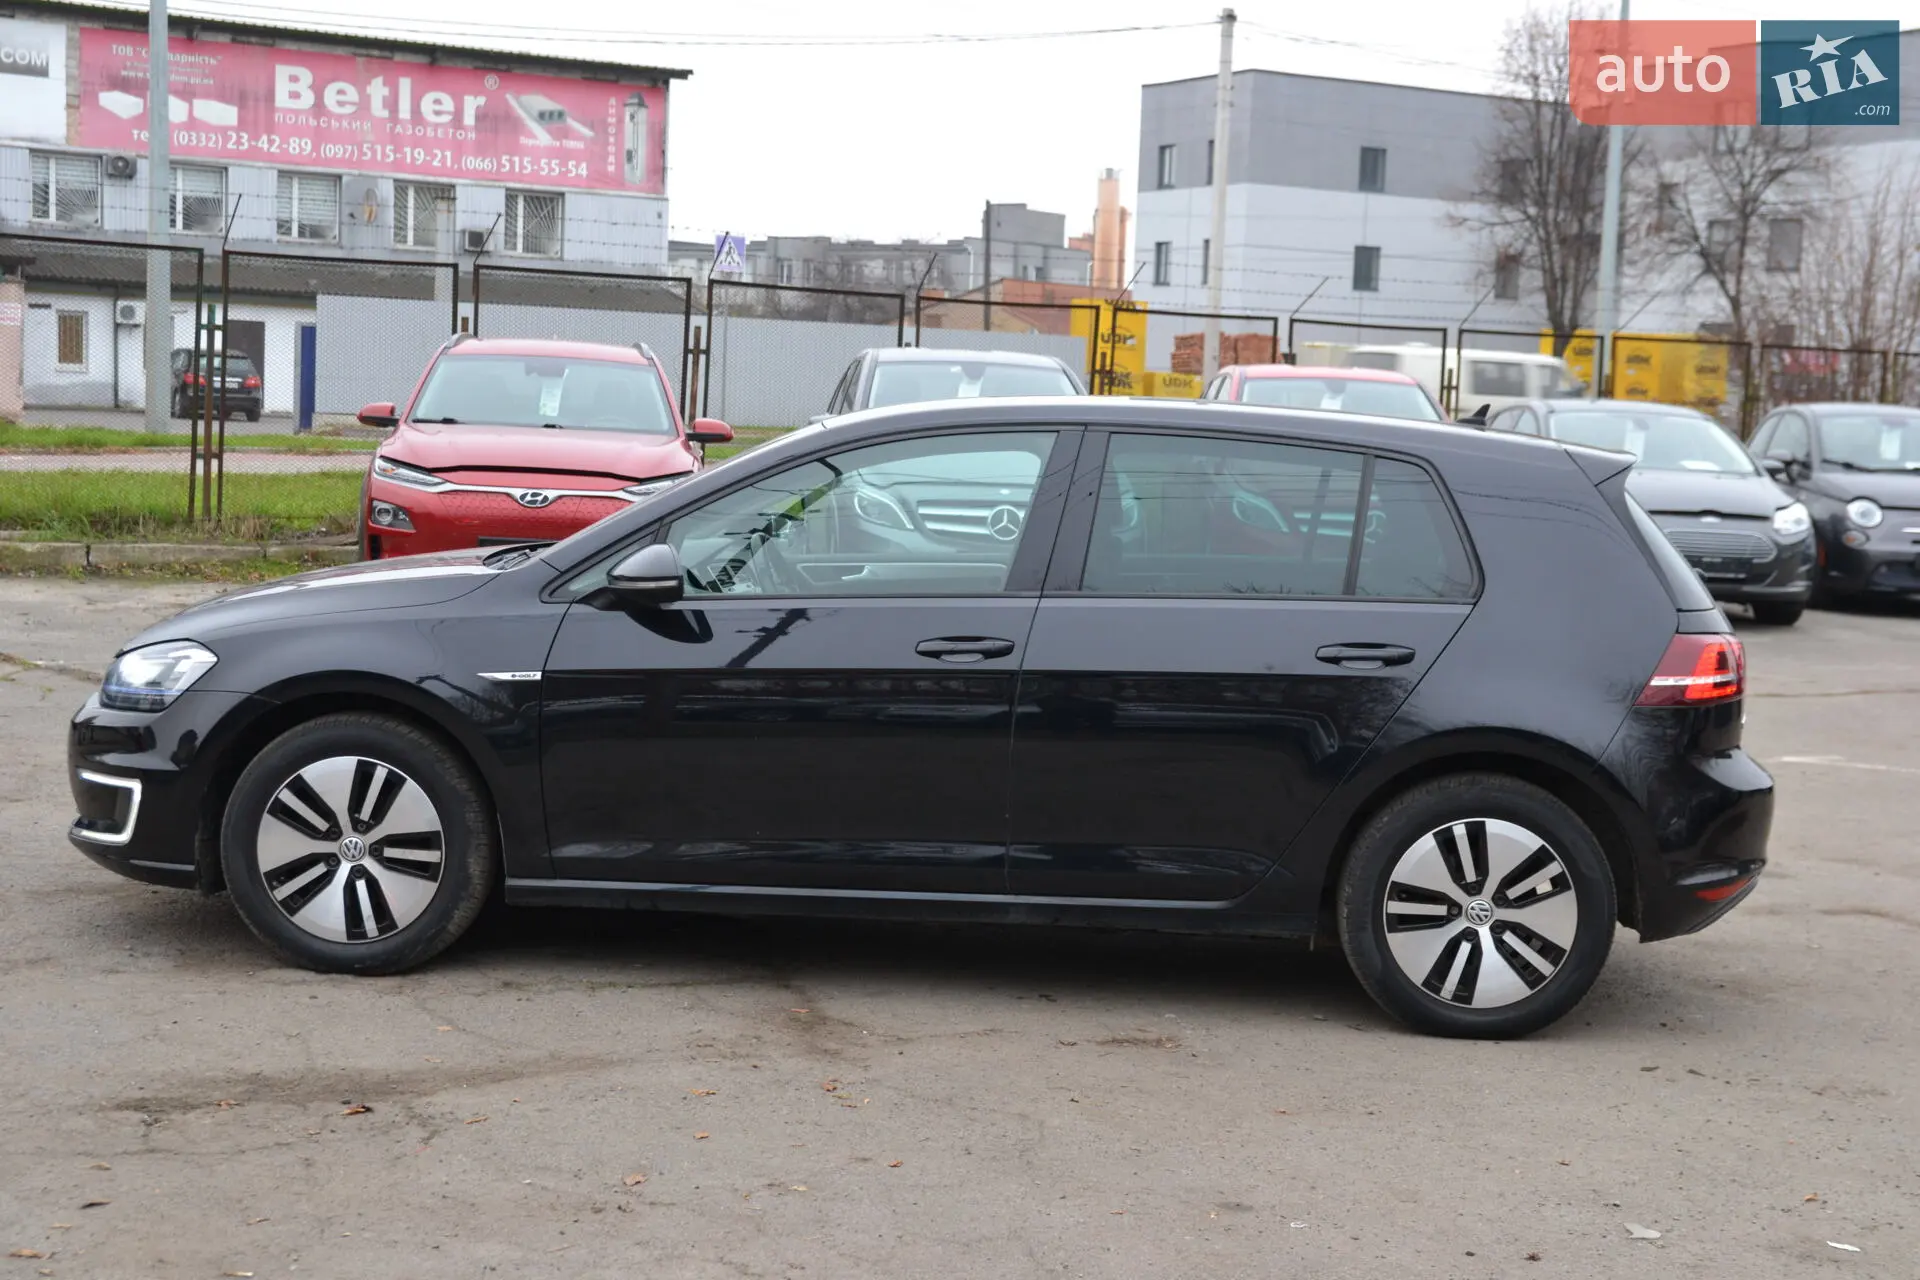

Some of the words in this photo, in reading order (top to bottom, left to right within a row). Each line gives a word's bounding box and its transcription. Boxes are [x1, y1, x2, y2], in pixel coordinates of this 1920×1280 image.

[112, 44, 133, 57] ТОВ
[275, 64, 487, 126] Betler
[275, 112, 372, 131] ПОЛЬСЬКИЙ
[386, 123, 476, 141] ГАЗОБЕТОН
[173, 130, 222, 150] (0332)
[320, 143, 358, 161] (097)
[461, 155, 497, 173] (066)
[500, 155, 588, 178] 515-55-54
